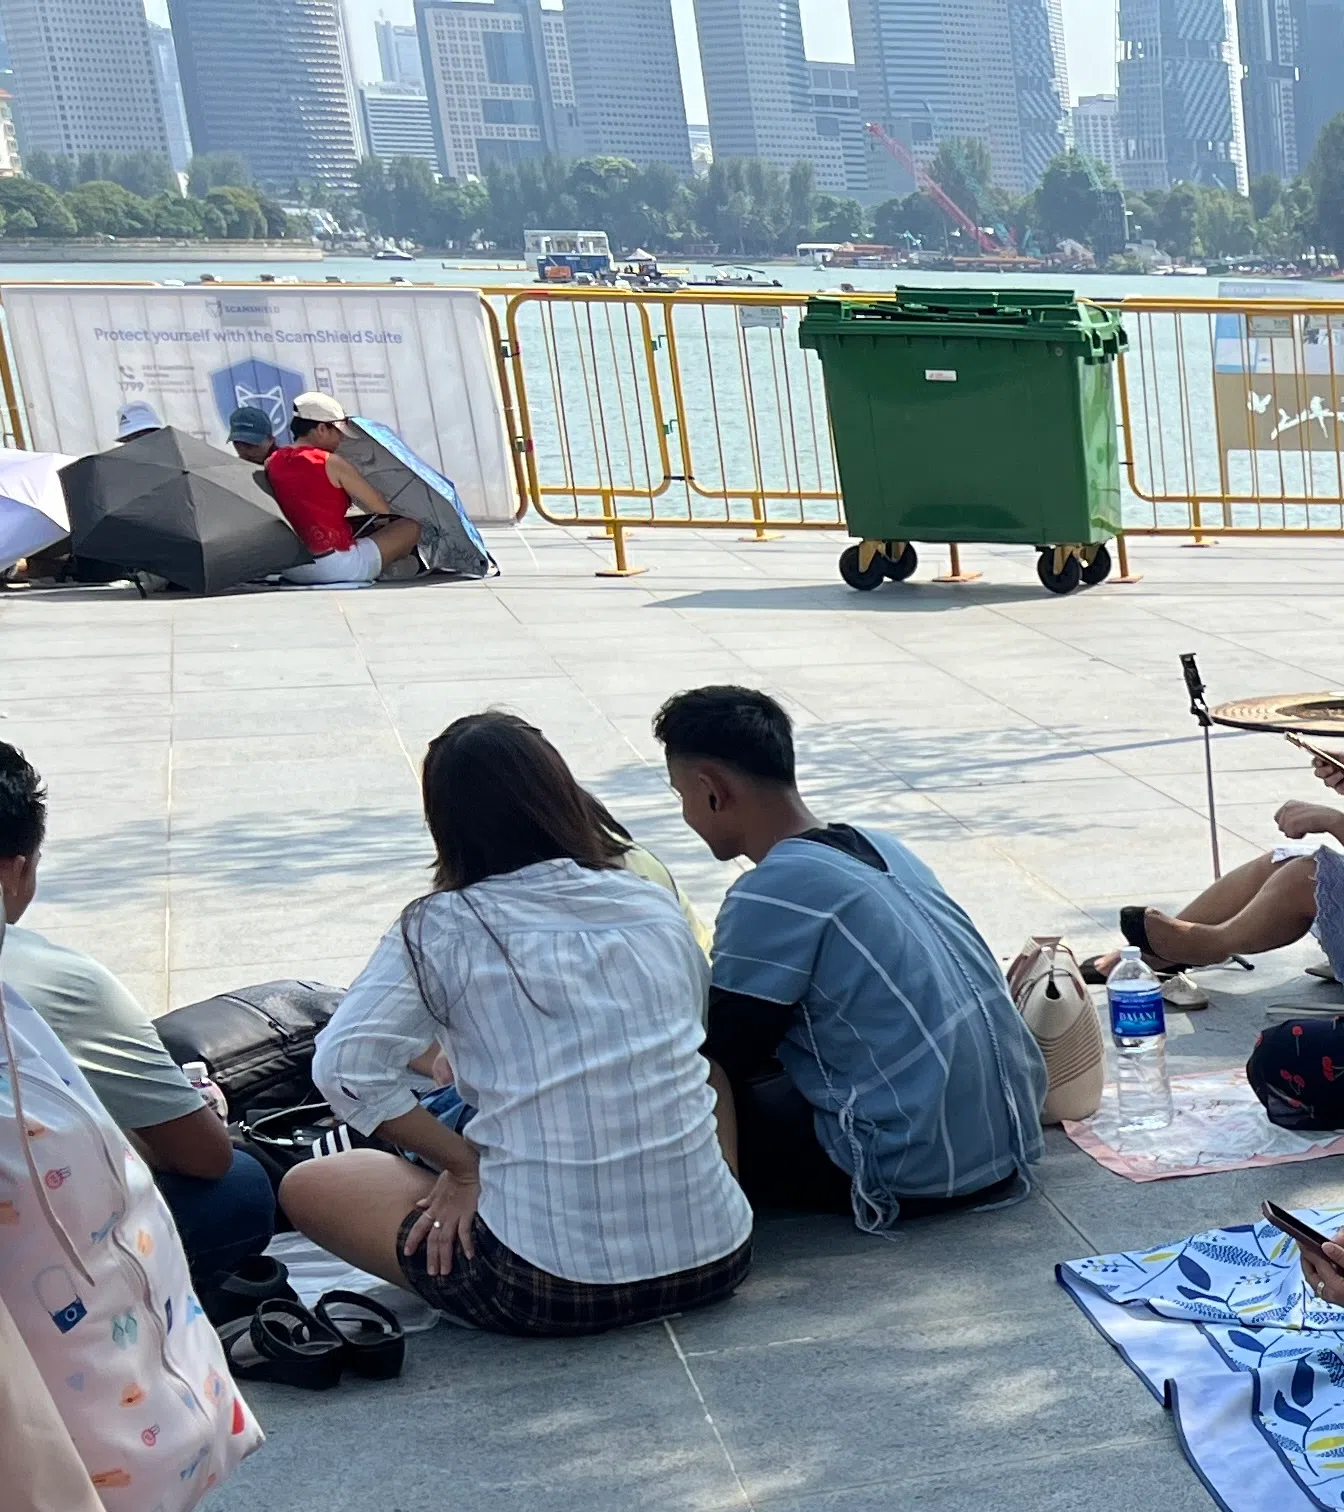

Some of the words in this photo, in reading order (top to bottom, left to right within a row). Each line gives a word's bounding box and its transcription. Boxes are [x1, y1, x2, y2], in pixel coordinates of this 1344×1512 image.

[94, 327, 149, 342] Protect
[153, 327, 210, 344] yourself
[213, 328, 246, 342] with
[250, 329, 273, 343] the
[276, 330, 362, 344] ScamShield
[365, 331, 403, 344] Suite
